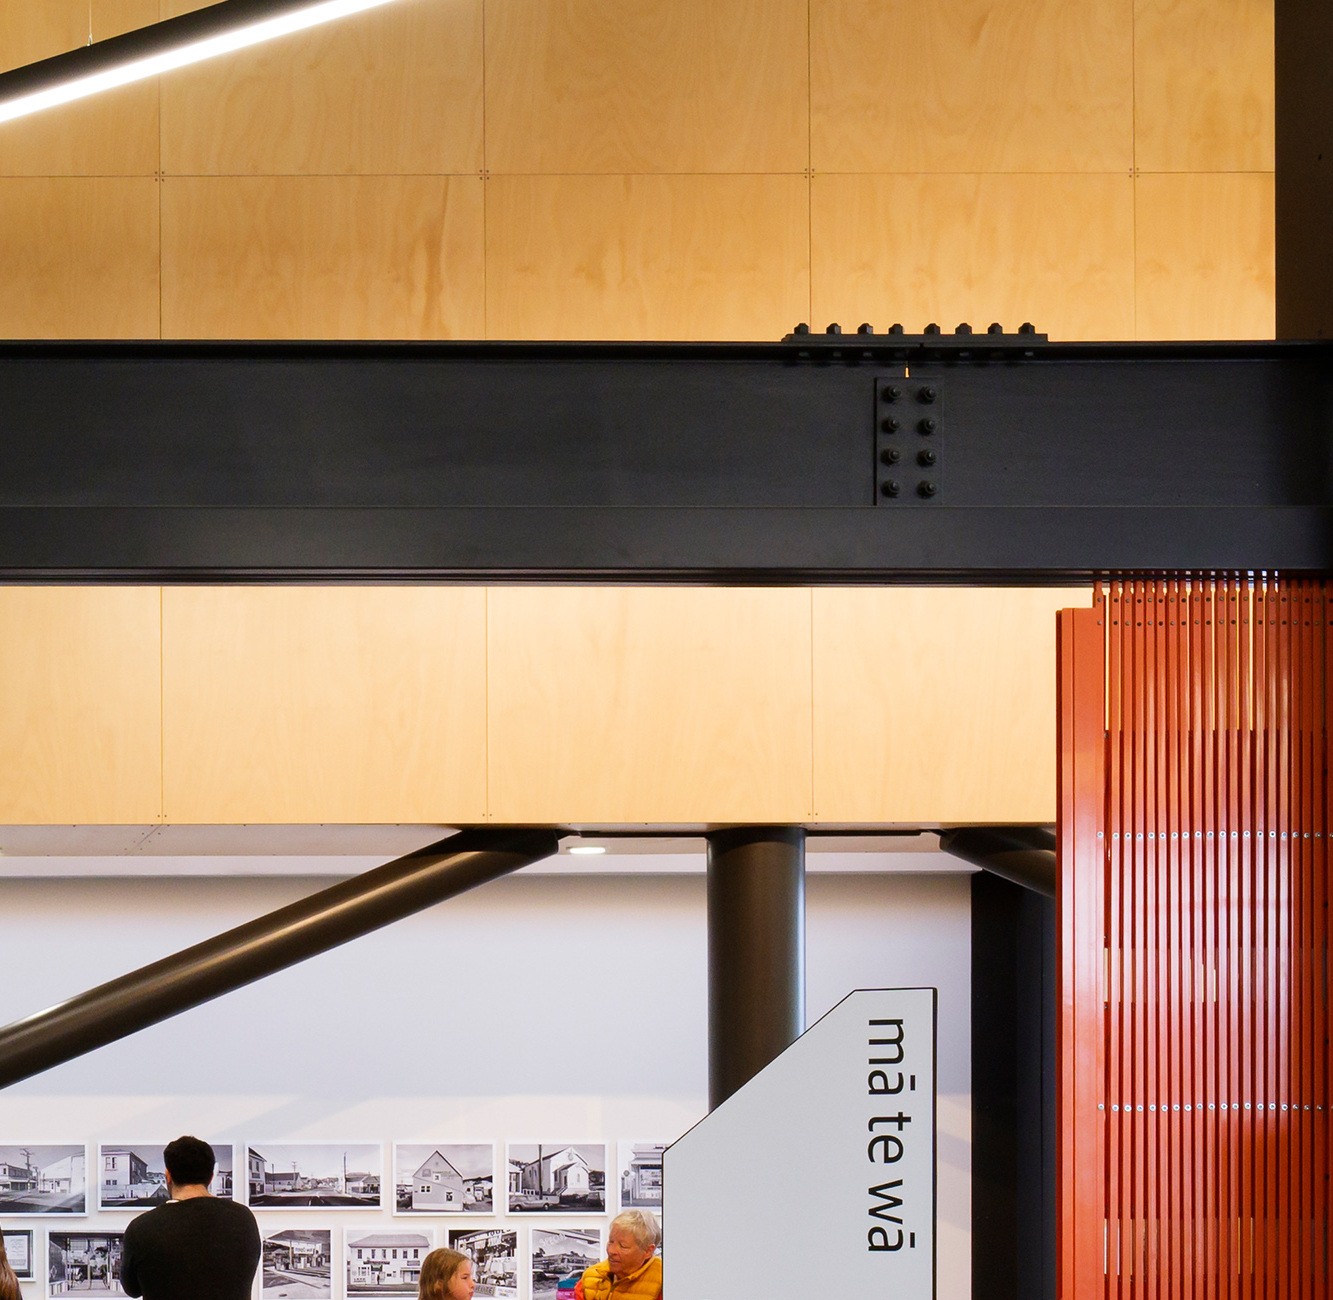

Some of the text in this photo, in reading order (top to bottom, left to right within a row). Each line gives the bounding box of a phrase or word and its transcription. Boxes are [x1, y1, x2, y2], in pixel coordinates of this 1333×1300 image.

[868, 1018, 916, 1252] mā te wā
